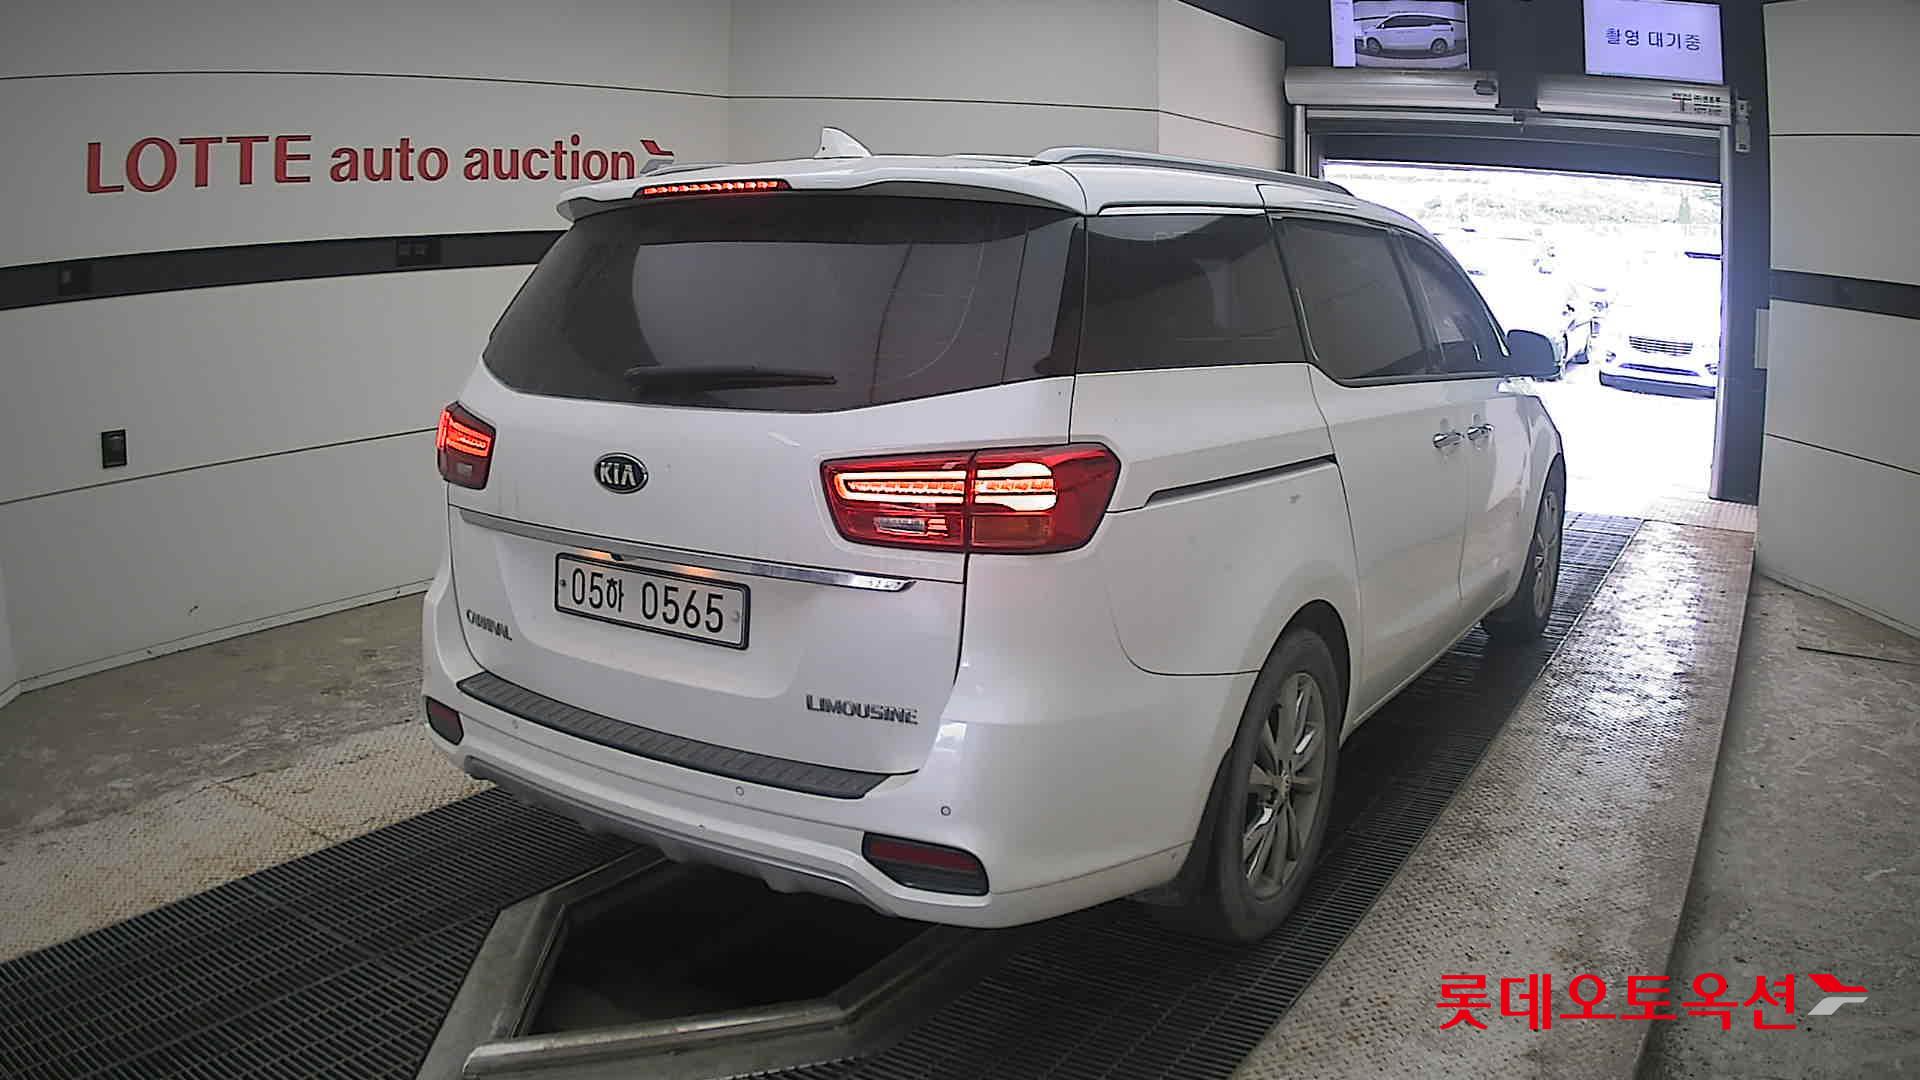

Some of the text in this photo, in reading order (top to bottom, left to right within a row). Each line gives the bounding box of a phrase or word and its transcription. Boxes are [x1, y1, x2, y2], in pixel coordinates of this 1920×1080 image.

[1606, 27, 1701, 52] 촬영 대기중
[87, 134, 637, 194] LOTTE auto auction
[600, 461, 637, 486] KIA
[572, 568, 724, 633] 05하 0565
[806, 694, 918, 725] LIMOUSINE
